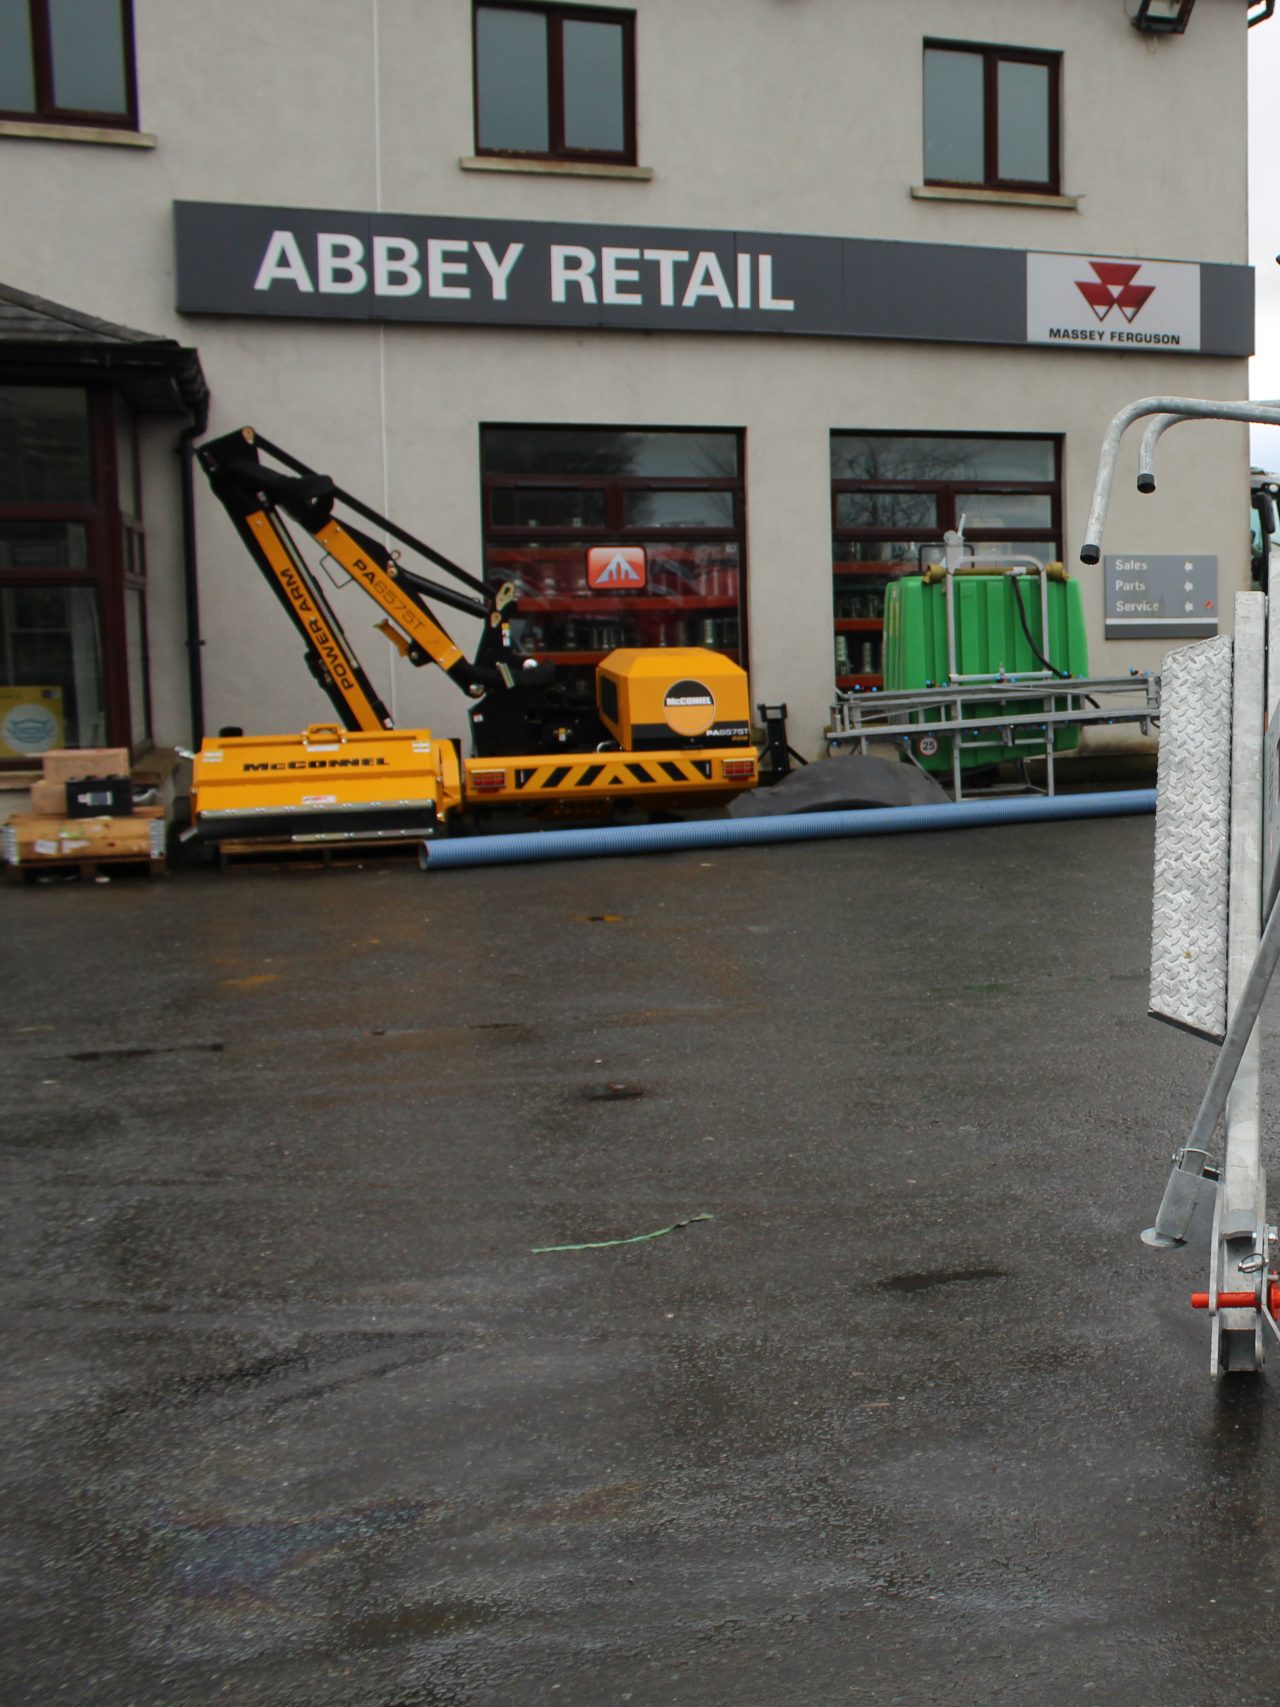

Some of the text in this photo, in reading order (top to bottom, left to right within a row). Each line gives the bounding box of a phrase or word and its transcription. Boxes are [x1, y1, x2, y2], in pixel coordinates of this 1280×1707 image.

[254, 230, 795, 311] ABBEY RETAIL
[1049, 327, 1180, 345] MASSEY FERGUSON
[1115, 559, 1148, 570] Sales
[1115, 580, 1146, 591] Parts
[352, 558, 426, 630] PA6575T
[1116, 600, 1160, 612] Service
[280, 567, 354, 690] POWER ARM
[922, 740, 935, 751] 25
